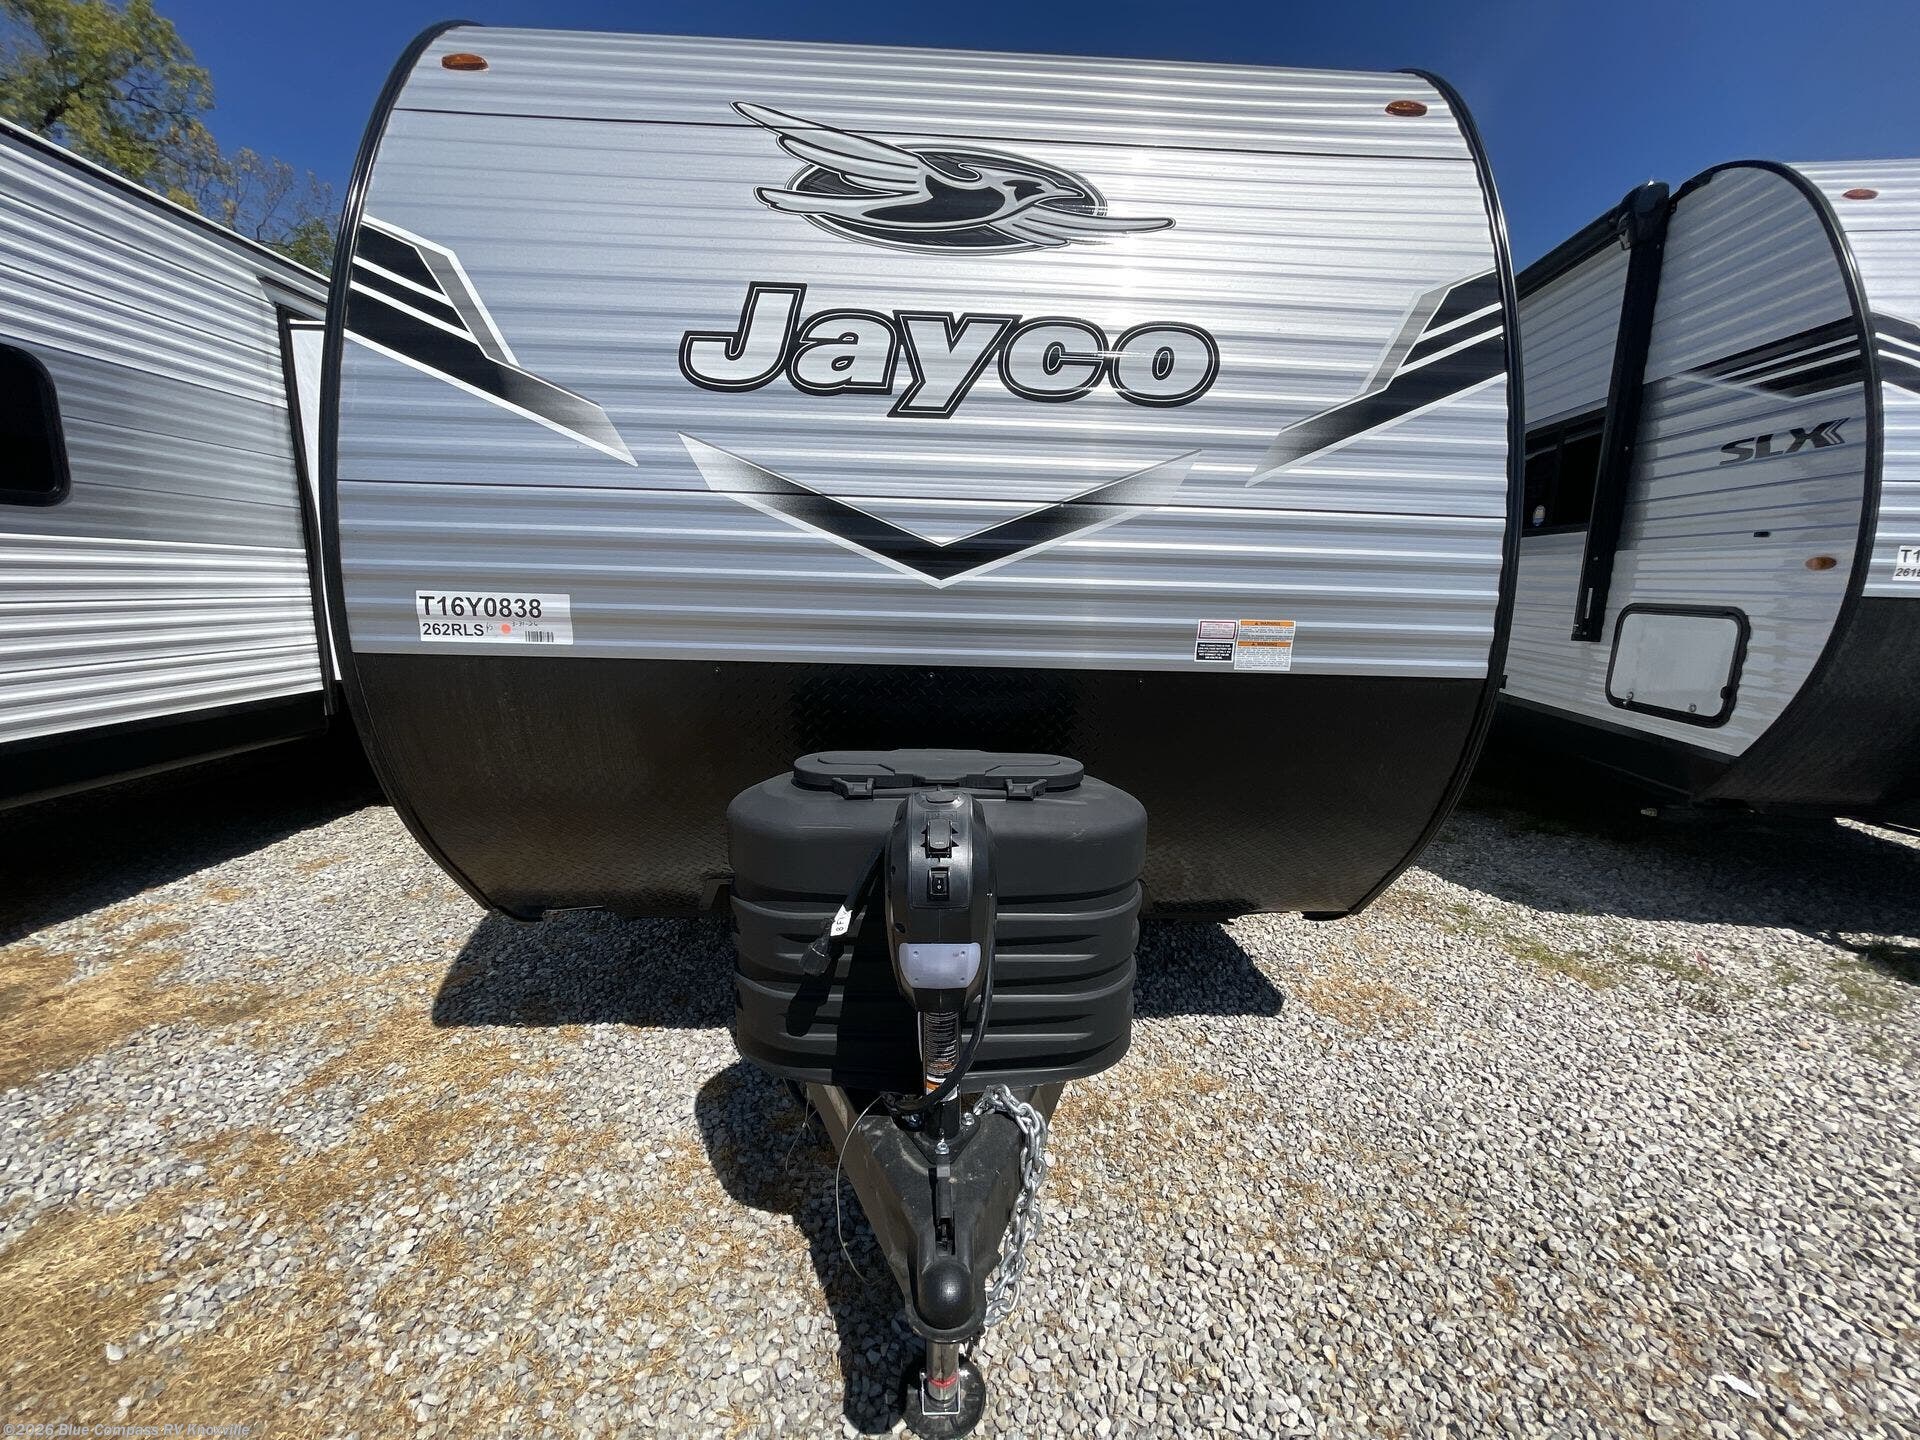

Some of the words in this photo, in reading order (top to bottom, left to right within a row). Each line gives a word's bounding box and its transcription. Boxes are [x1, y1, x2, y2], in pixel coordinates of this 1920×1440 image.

[679, 281, 1220, 419] Jayco
[1720, 417, 1850, 465] SLX
[419, 596, 542, 618] T16Y0838
[422, 623, 484, 637] 262RLS
